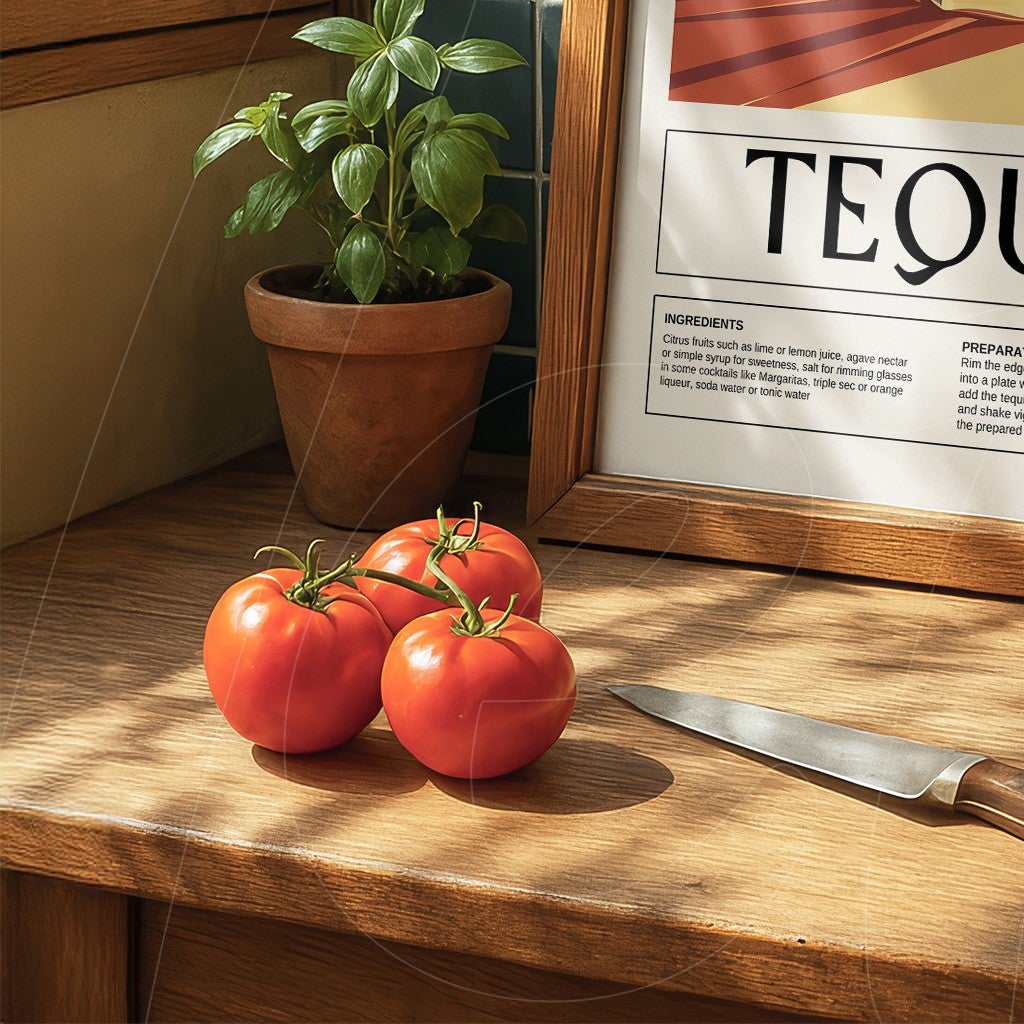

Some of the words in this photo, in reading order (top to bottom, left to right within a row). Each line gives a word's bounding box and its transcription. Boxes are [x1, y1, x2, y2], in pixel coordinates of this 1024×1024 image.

[664, 312, 744, 331] INGREDIENTS
[662, 333, 690, 346] Citrus
[691, 335, 715, 348] fruits
[716, 339, 739, 351] such
[740, 342, 752, 352] as
[754, 342, 774, 355] lime
[775, 346, 786, 355] or
[788, 345, 817, 358] lemon
[818, 348, 844, 362] juice,
[846, 353, 875, 364] agave
[877, 356, 908, 367] nectar
[661, 349, 671, 358] or
[672, 348, 704, 362] simple
[705, 353, 731, 366] syrup
[732, 353, 747, 365] for
[747, 356, 800, 372] sweetness,
[801, 362, 819, 373] salt
[820, 363, 835, 374] for
[835, 364, 874, 380] rimming
[876, 369, 912, 382] glasses
[961, 357, 982, 369] Rim
[984, 359, 1001, 371] the
[659, 374, 693, 390] liqueur,
[695, 380, 718, 391] soda
[720, 383, 747, 394] water
[747, 386, 759, 395] or
[759, 386, 783, 398] tonic
[784, 390, 811, 400] water
[660, 360, 669, 372] in
[670, 364, 697, 375] some
[698, 366, 739, 379] cocktails
[740, 369, 756, 381] like
[758, 370, 810, 387] Margaritas,
[813, 377, 837, 390] triple
[838, 381, 856, 391] sec
[857, 383, 868, 392] or
[869, 384, 903, 397] orange
[959, 371, 979, 384] into
[981, 376, 989, 386] a
[990, 375, 1016, 389] plate
[958, 388, 979, 400] add
[980, 389, 998, 402] the
[957, 404, 978, 415] and
[979, 405, 1011, 419] shake
[956, 418, 973, 431] the
[975, 422, 1022, 436] prepared
